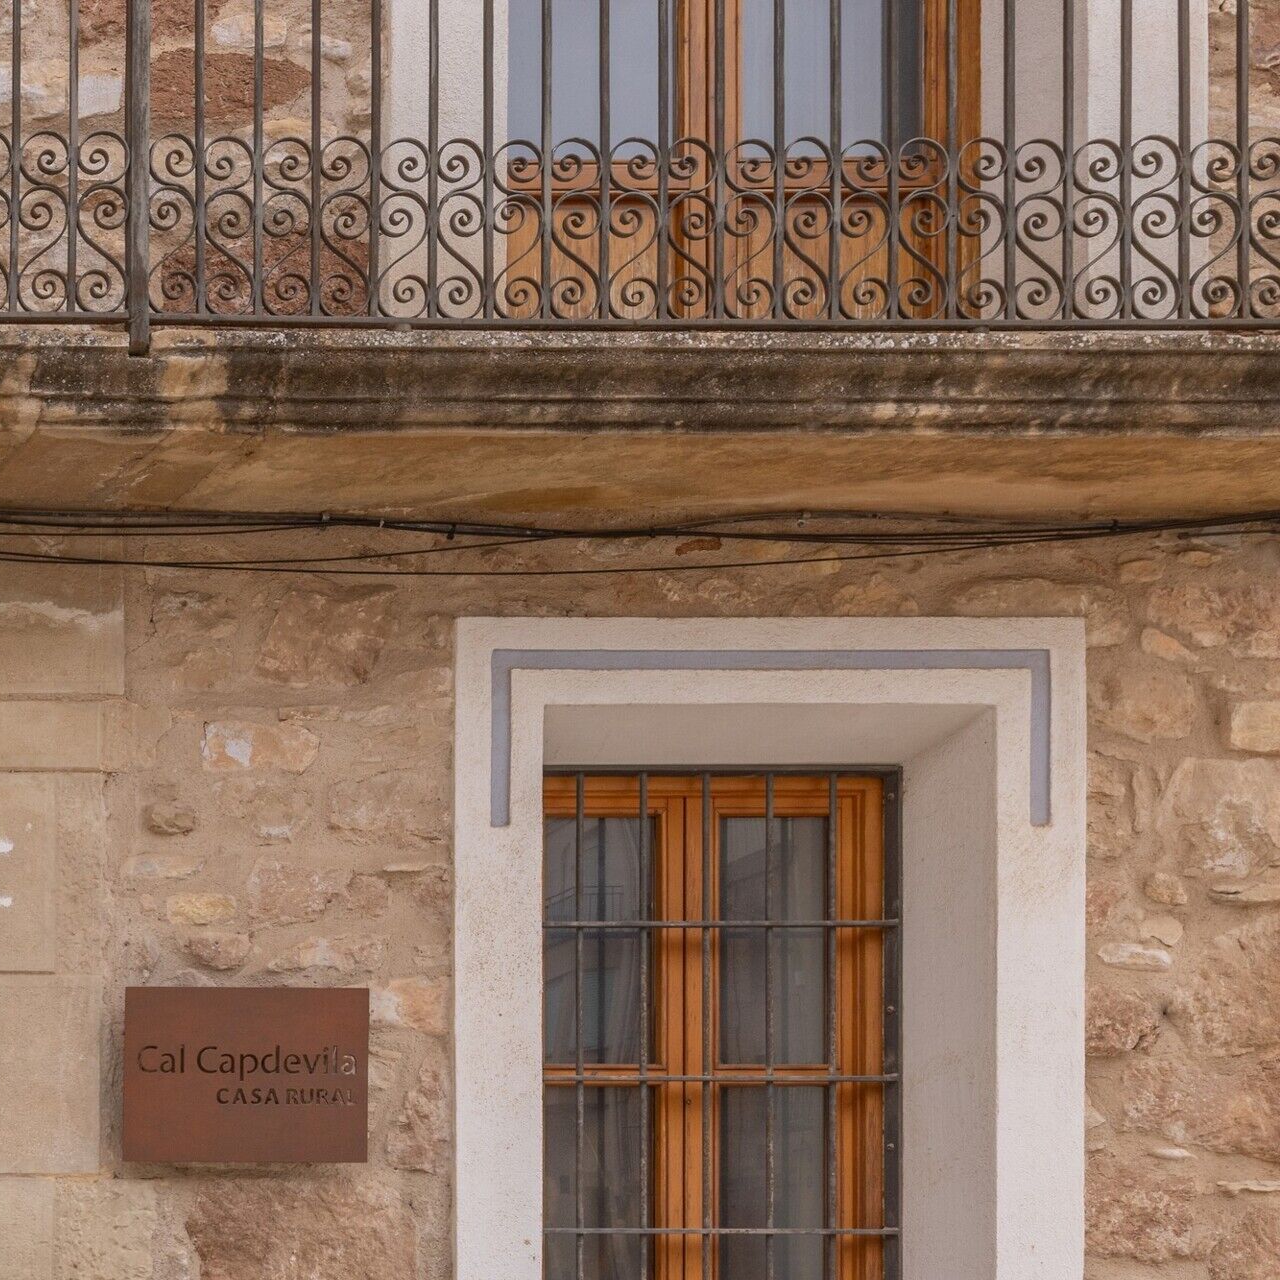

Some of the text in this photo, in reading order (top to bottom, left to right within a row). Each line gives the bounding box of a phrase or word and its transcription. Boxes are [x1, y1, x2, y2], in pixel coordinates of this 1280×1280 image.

[138, 1044, 357, 1081] Cal Capdevila
[216, 1088, 358, 1105] CASA RURAL
